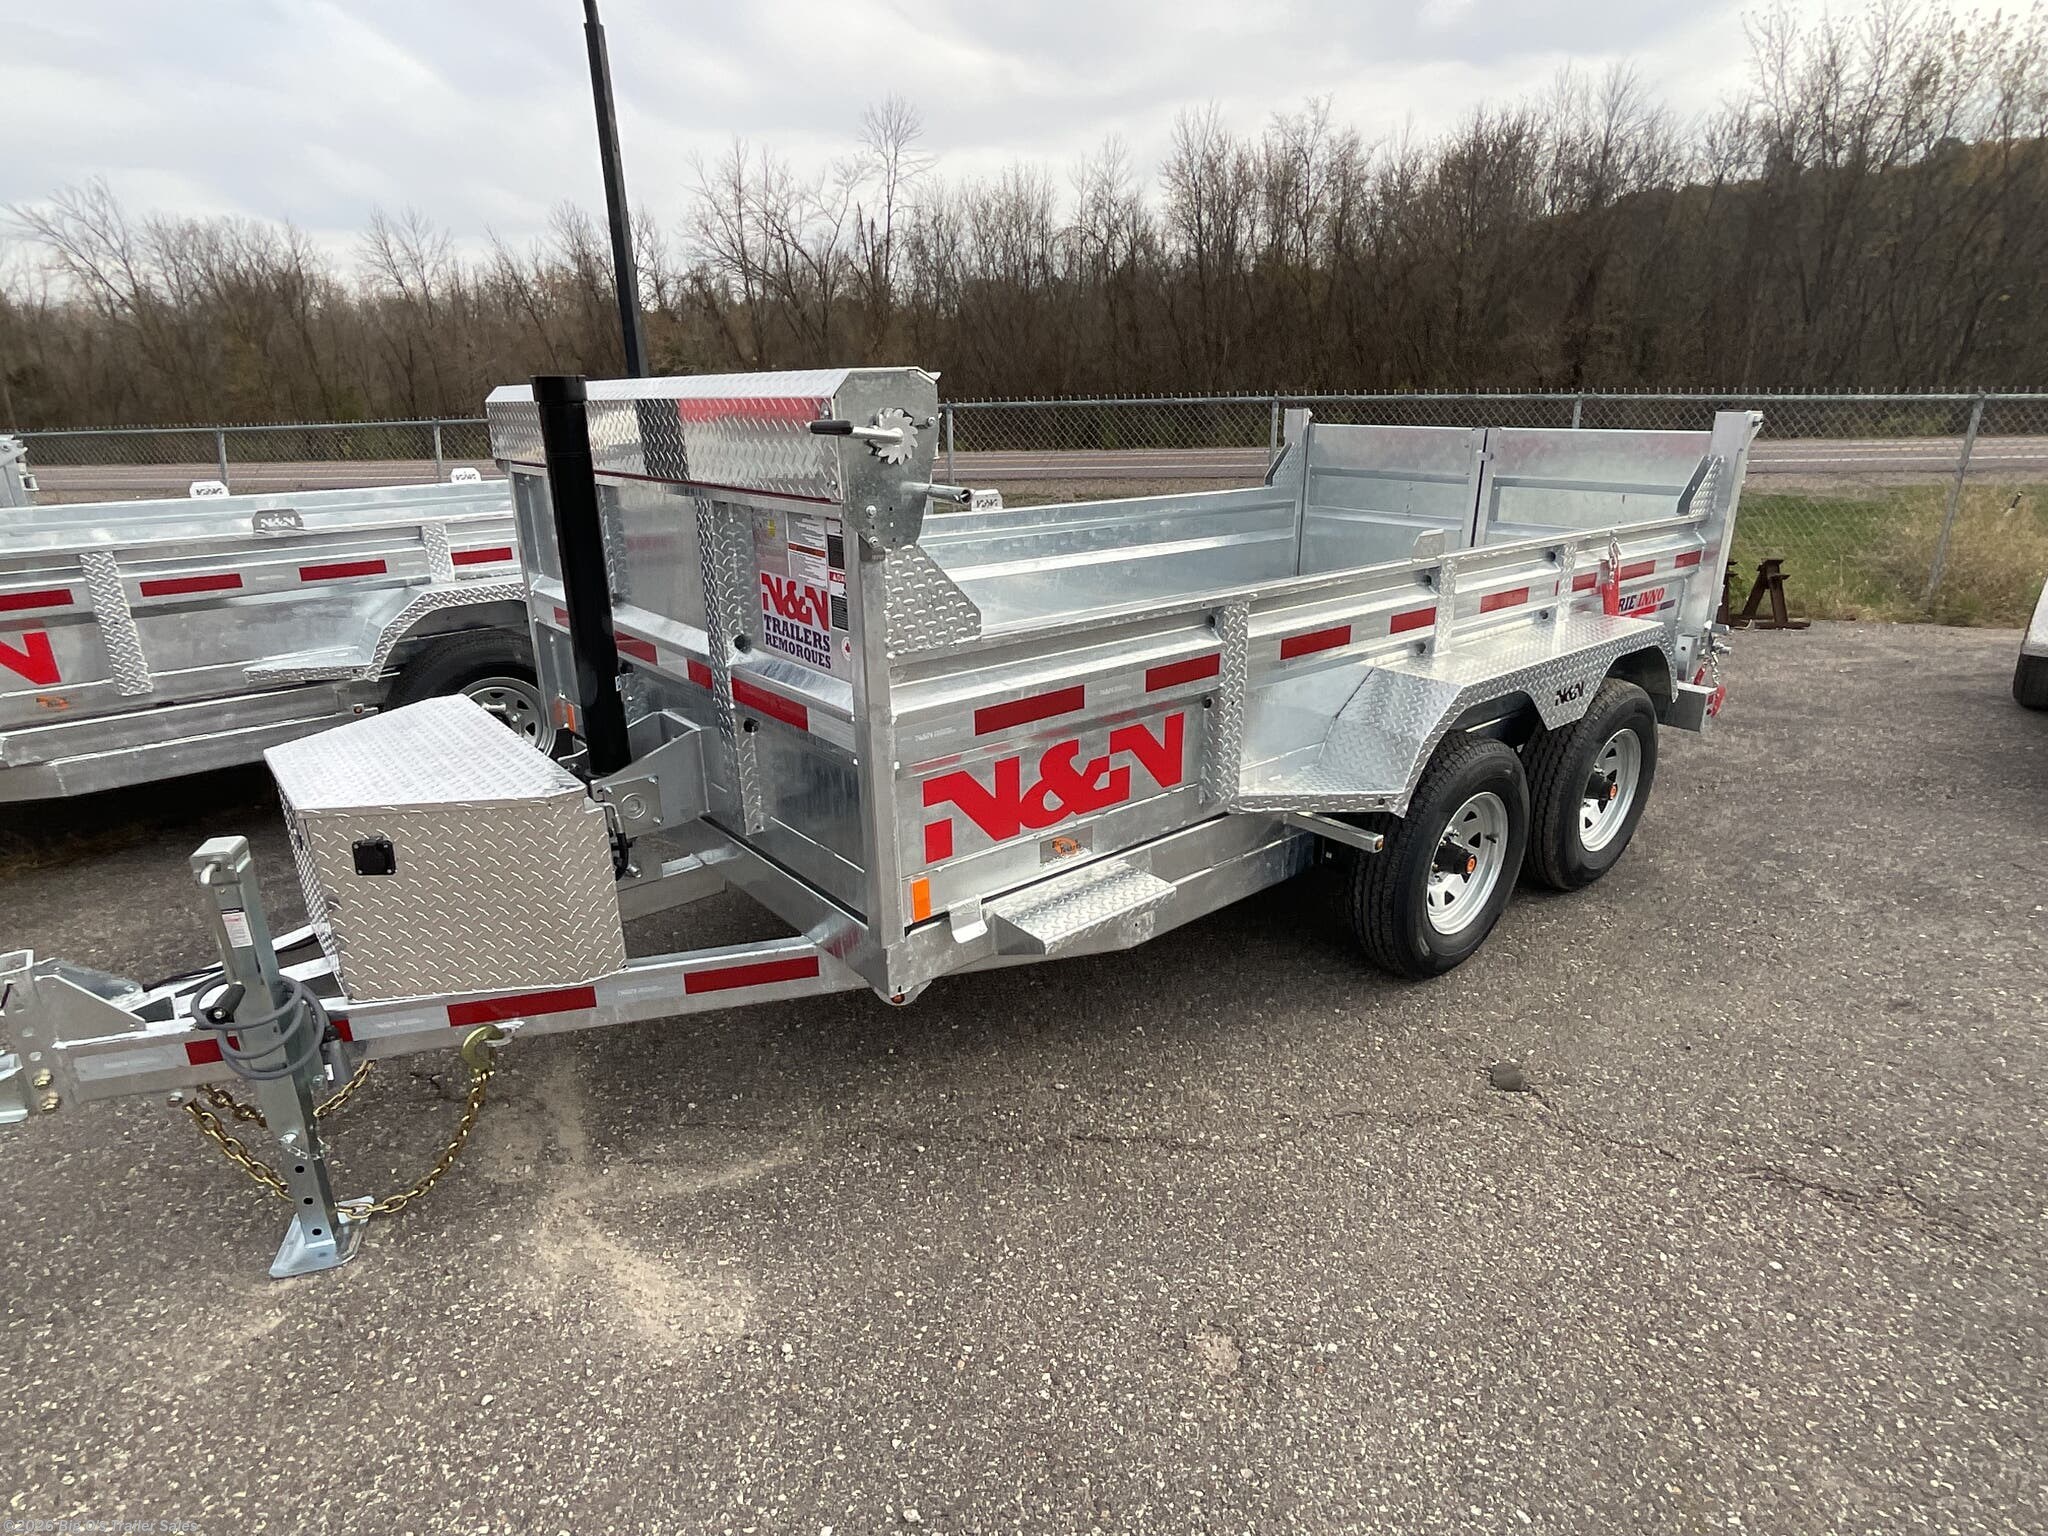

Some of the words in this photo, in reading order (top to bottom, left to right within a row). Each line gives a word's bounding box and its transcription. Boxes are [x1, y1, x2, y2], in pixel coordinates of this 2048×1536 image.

[260, 513, 296, 528] N&N
[761, 572, 830, 632] N&N
[1637, 587, 1665, 608] INNO
[763, 613, 831, 653] TRAILERS
[764, 632, 832, 670] REMORQUES
[922, 711, 1185, 865] N&N
